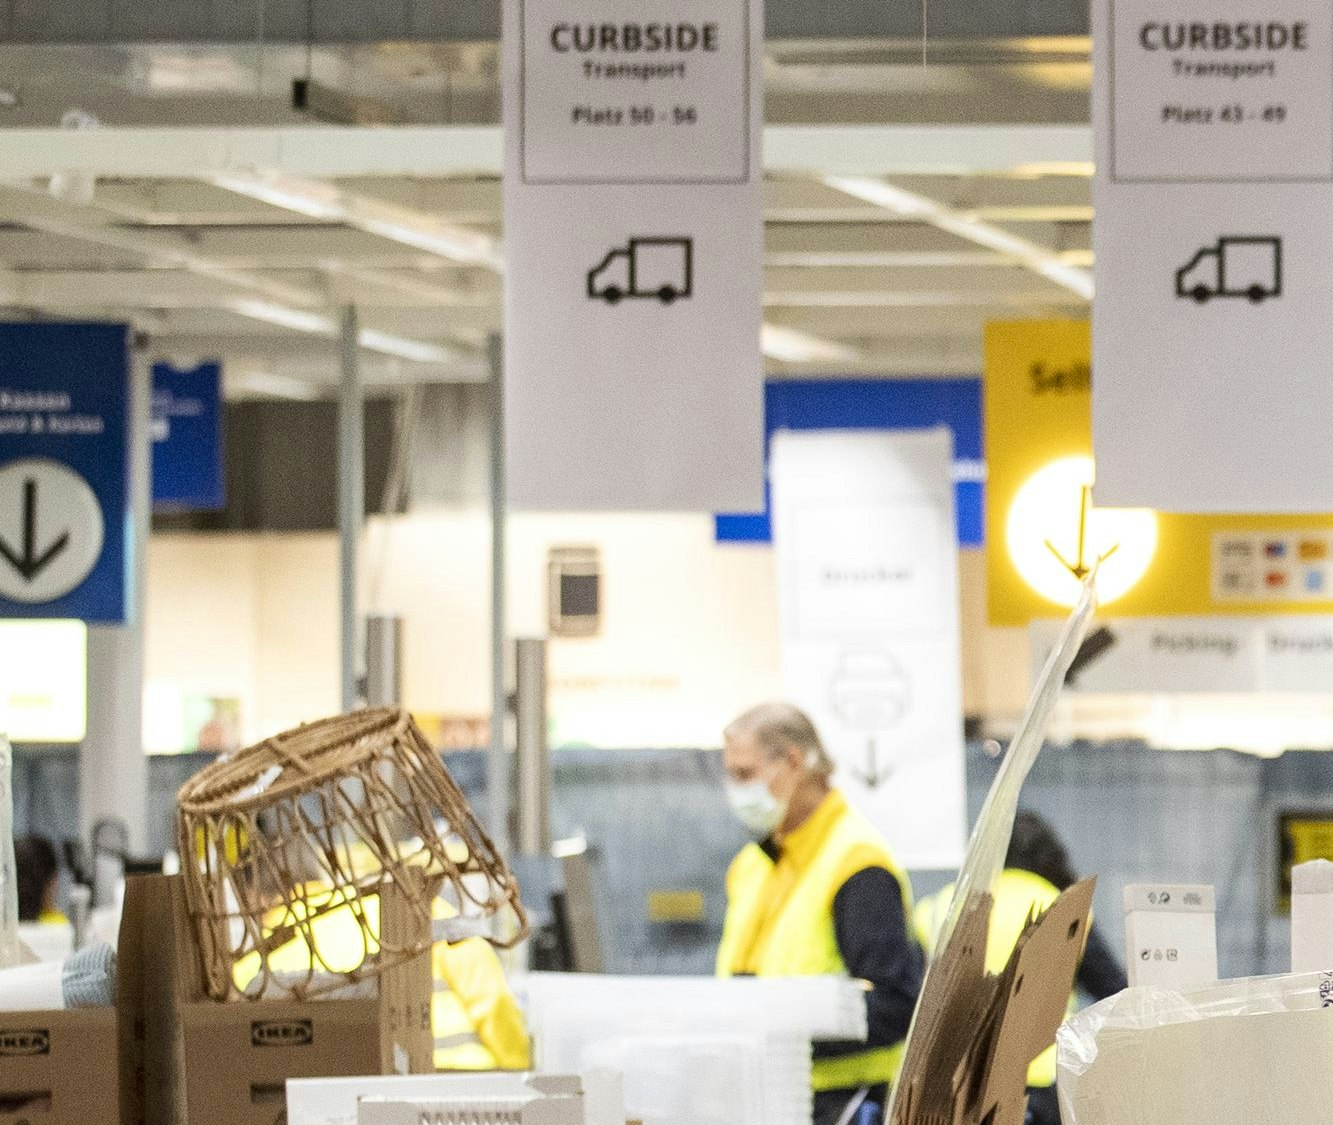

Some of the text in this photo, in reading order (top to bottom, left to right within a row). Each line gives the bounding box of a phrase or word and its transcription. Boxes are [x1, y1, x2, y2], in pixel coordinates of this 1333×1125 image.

[551, 22, 719, 53] CURBSIDE
[1139, 21, 1307, 51] CURBSIDE
[583, 60, 685, 82] Transport
[1172, 59, 1275, 80] Transport
[571, 106, 623, 126] Platz
[629, 106, 654, 126] 50
[1161, 105, 1213, 125] Platz
[1220, 105, 1243, 124] 43
[1262, 105, 1287, 123] 49
[255, 1026, 309, 1040] IKEA
